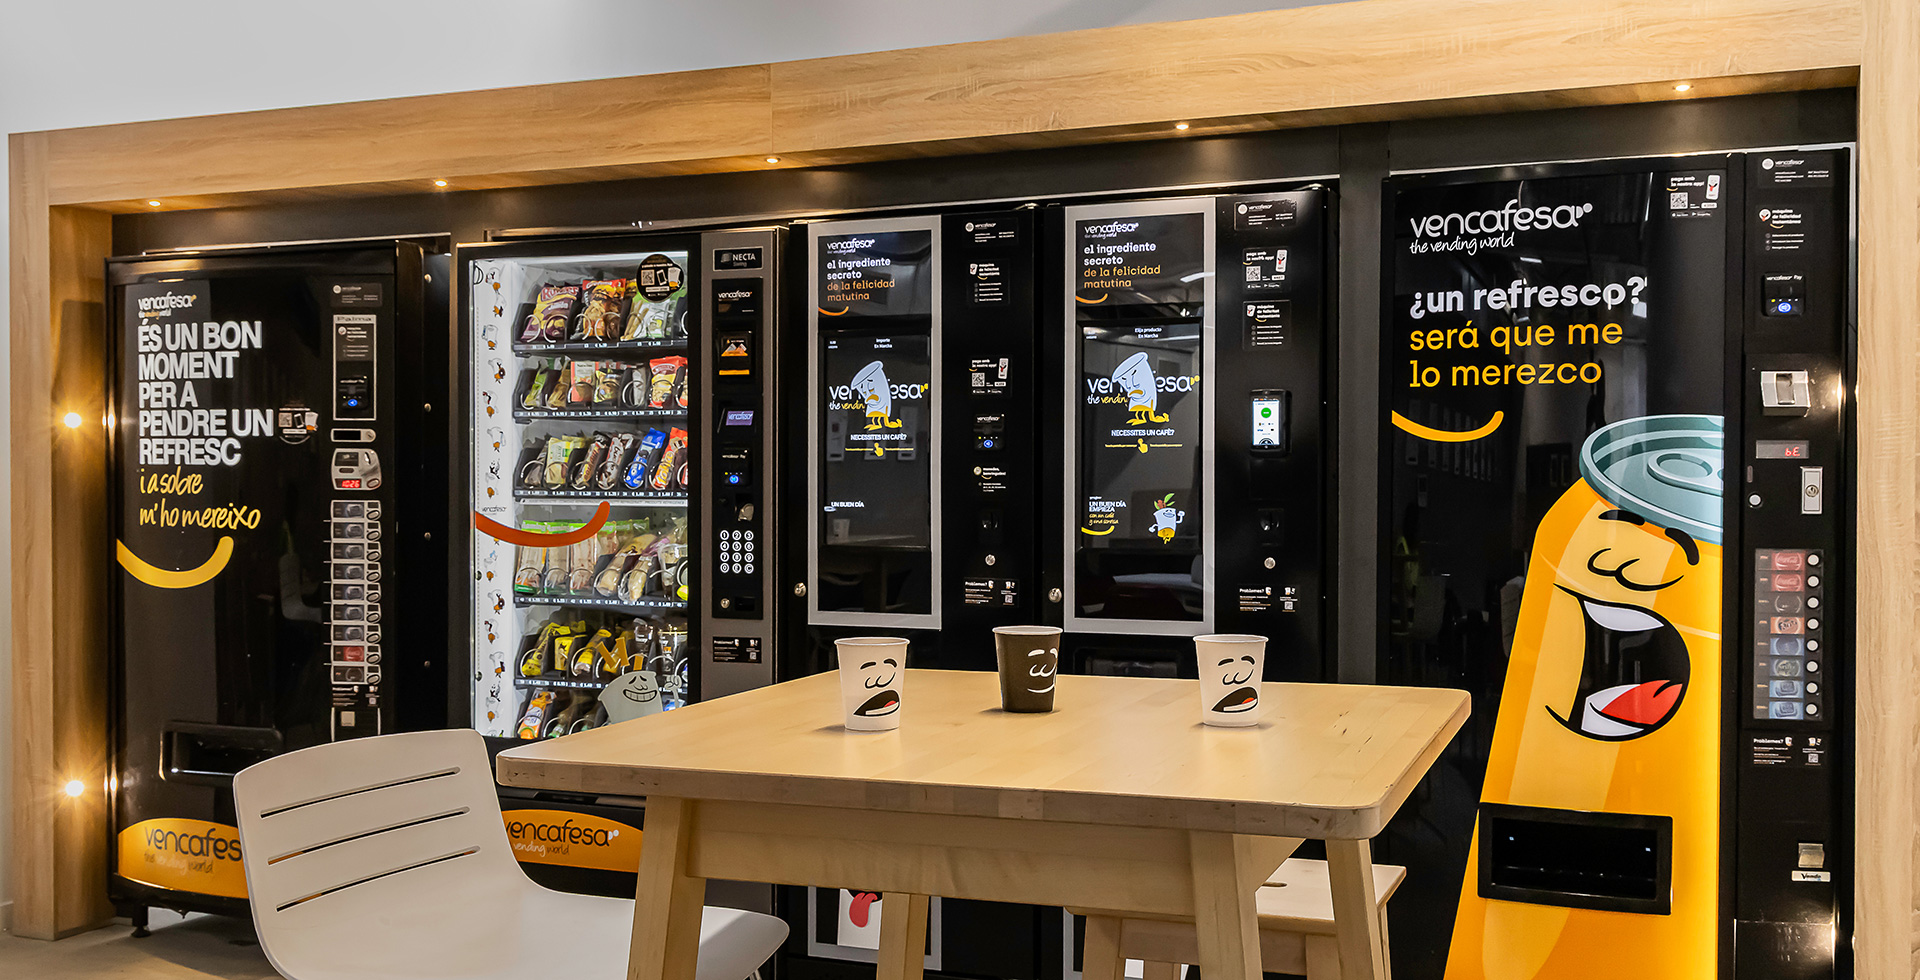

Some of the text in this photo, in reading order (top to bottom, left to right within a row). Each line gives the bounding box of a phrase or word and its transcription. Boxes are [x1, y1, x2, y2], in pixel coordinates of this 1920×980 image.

[1084, 221, 1135, 234] vencafesa
[1410, 199, 1579, 238] vencafesa
[1084, 242, 1157, 256] el ingrediente
[1409, 231, 1515, 256] the vending world
[732, 253, 756, 261] NECTA
[827, 257, 891, 270] el ingrediente
[1083, 256, 1123, 266] secreto
[827, 270, 862, 280] secreto
[1083, 264, 1161, 277] de la felicidad
[827, 278, 895, 291] de la felicidad
[1083, 279, 1132, 289] matutina
[827, 292, 870, 302] matutina
[1409, 276, 1645, 320] ¿un refresco?
[138, 318, 262, 352] ÉS UN BON
[1409, 320, 1624, 355] será que me
[138, 351, 240, 381] MOMENT
[1409, 360, 1603, 388] lo merezco
[139, 380, 199, 409] PER A
[1101, 393, 1128, 407] vendin
[841, 400, 866, 413] vendin
[139, 408, 274, 437] PENDRE UN
[1111, 429, 1146, 437] NECESSITES
[139, 437, 242, 466] REFRESC
[160, 465, 203, 496] sobre
[181, 502, 262, 530] mereixo
[145, 827, 243, 862] vencafes
